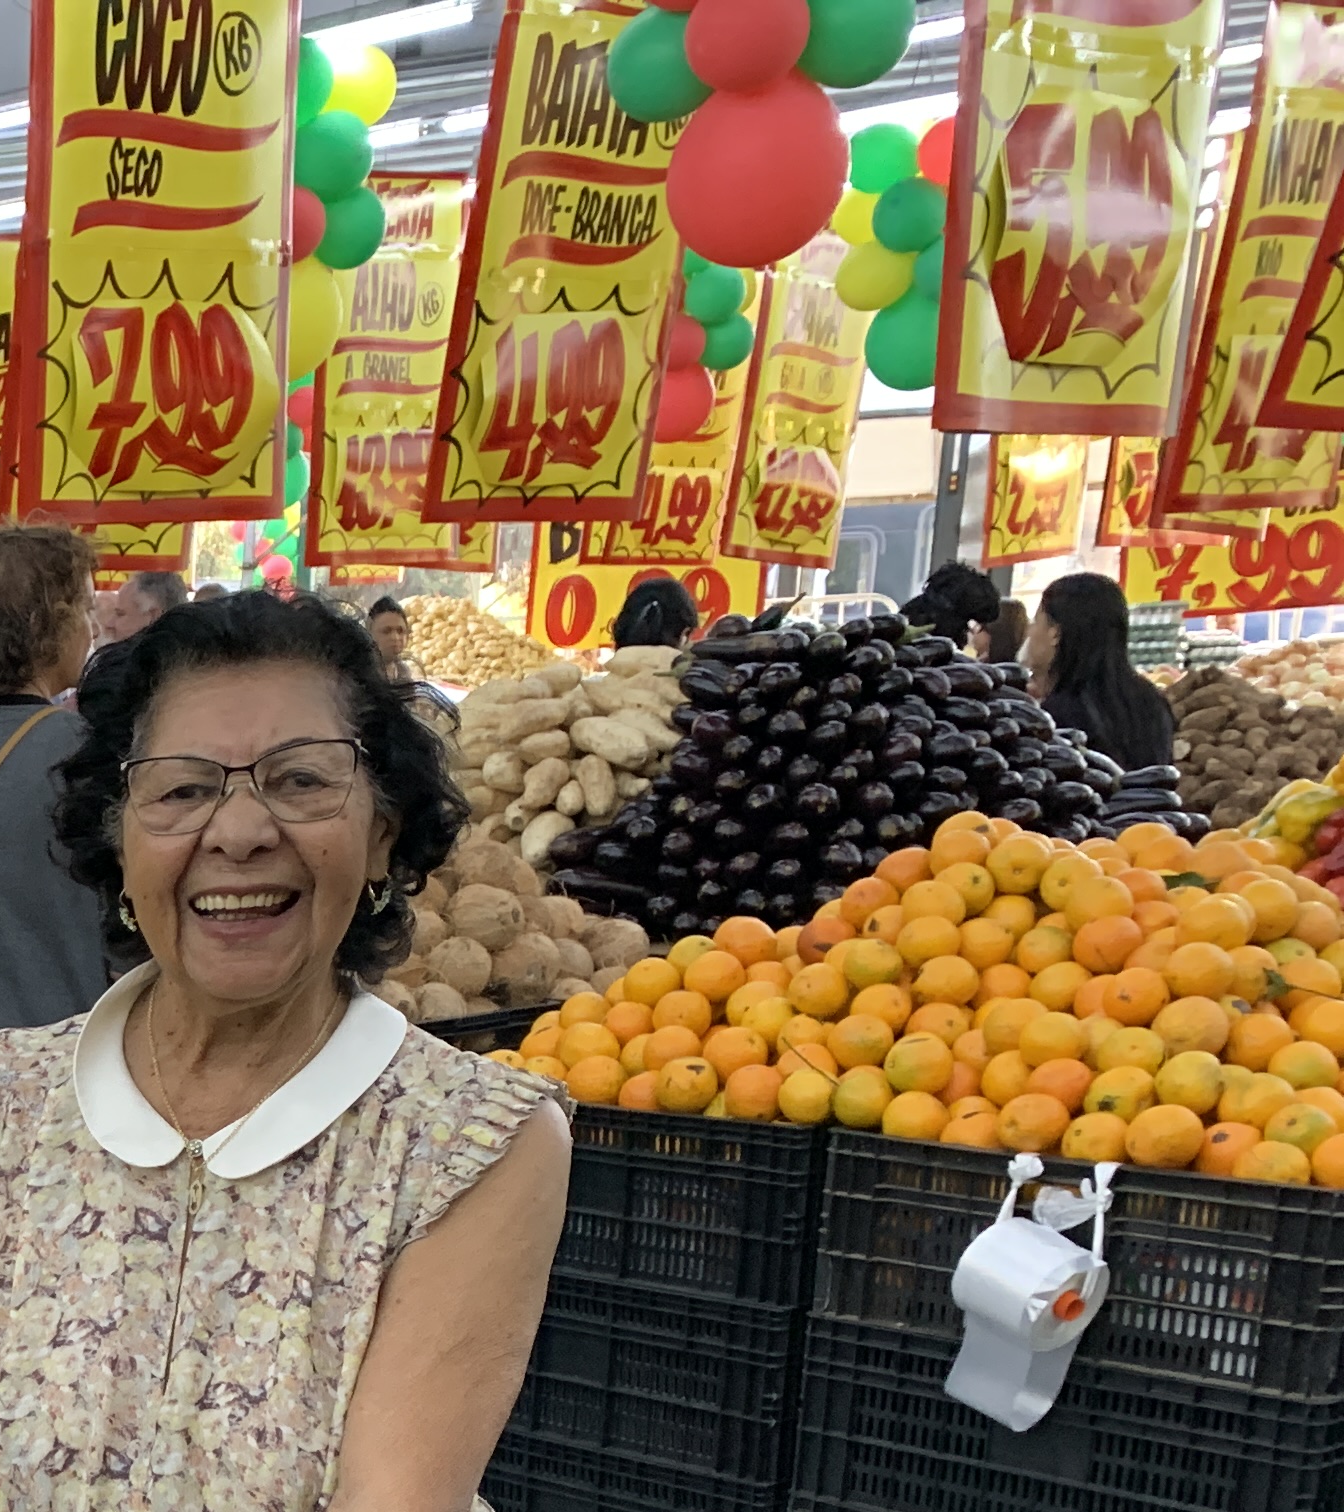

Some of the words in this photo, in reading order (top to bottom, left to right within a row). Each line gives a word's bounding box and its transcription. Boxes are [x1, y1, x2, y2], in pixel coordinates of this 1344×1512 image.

[96, 0, 213, 116] COCO
[78, 300, 254, 489] 7,99
[479, 316, 626, 486] 4,99
